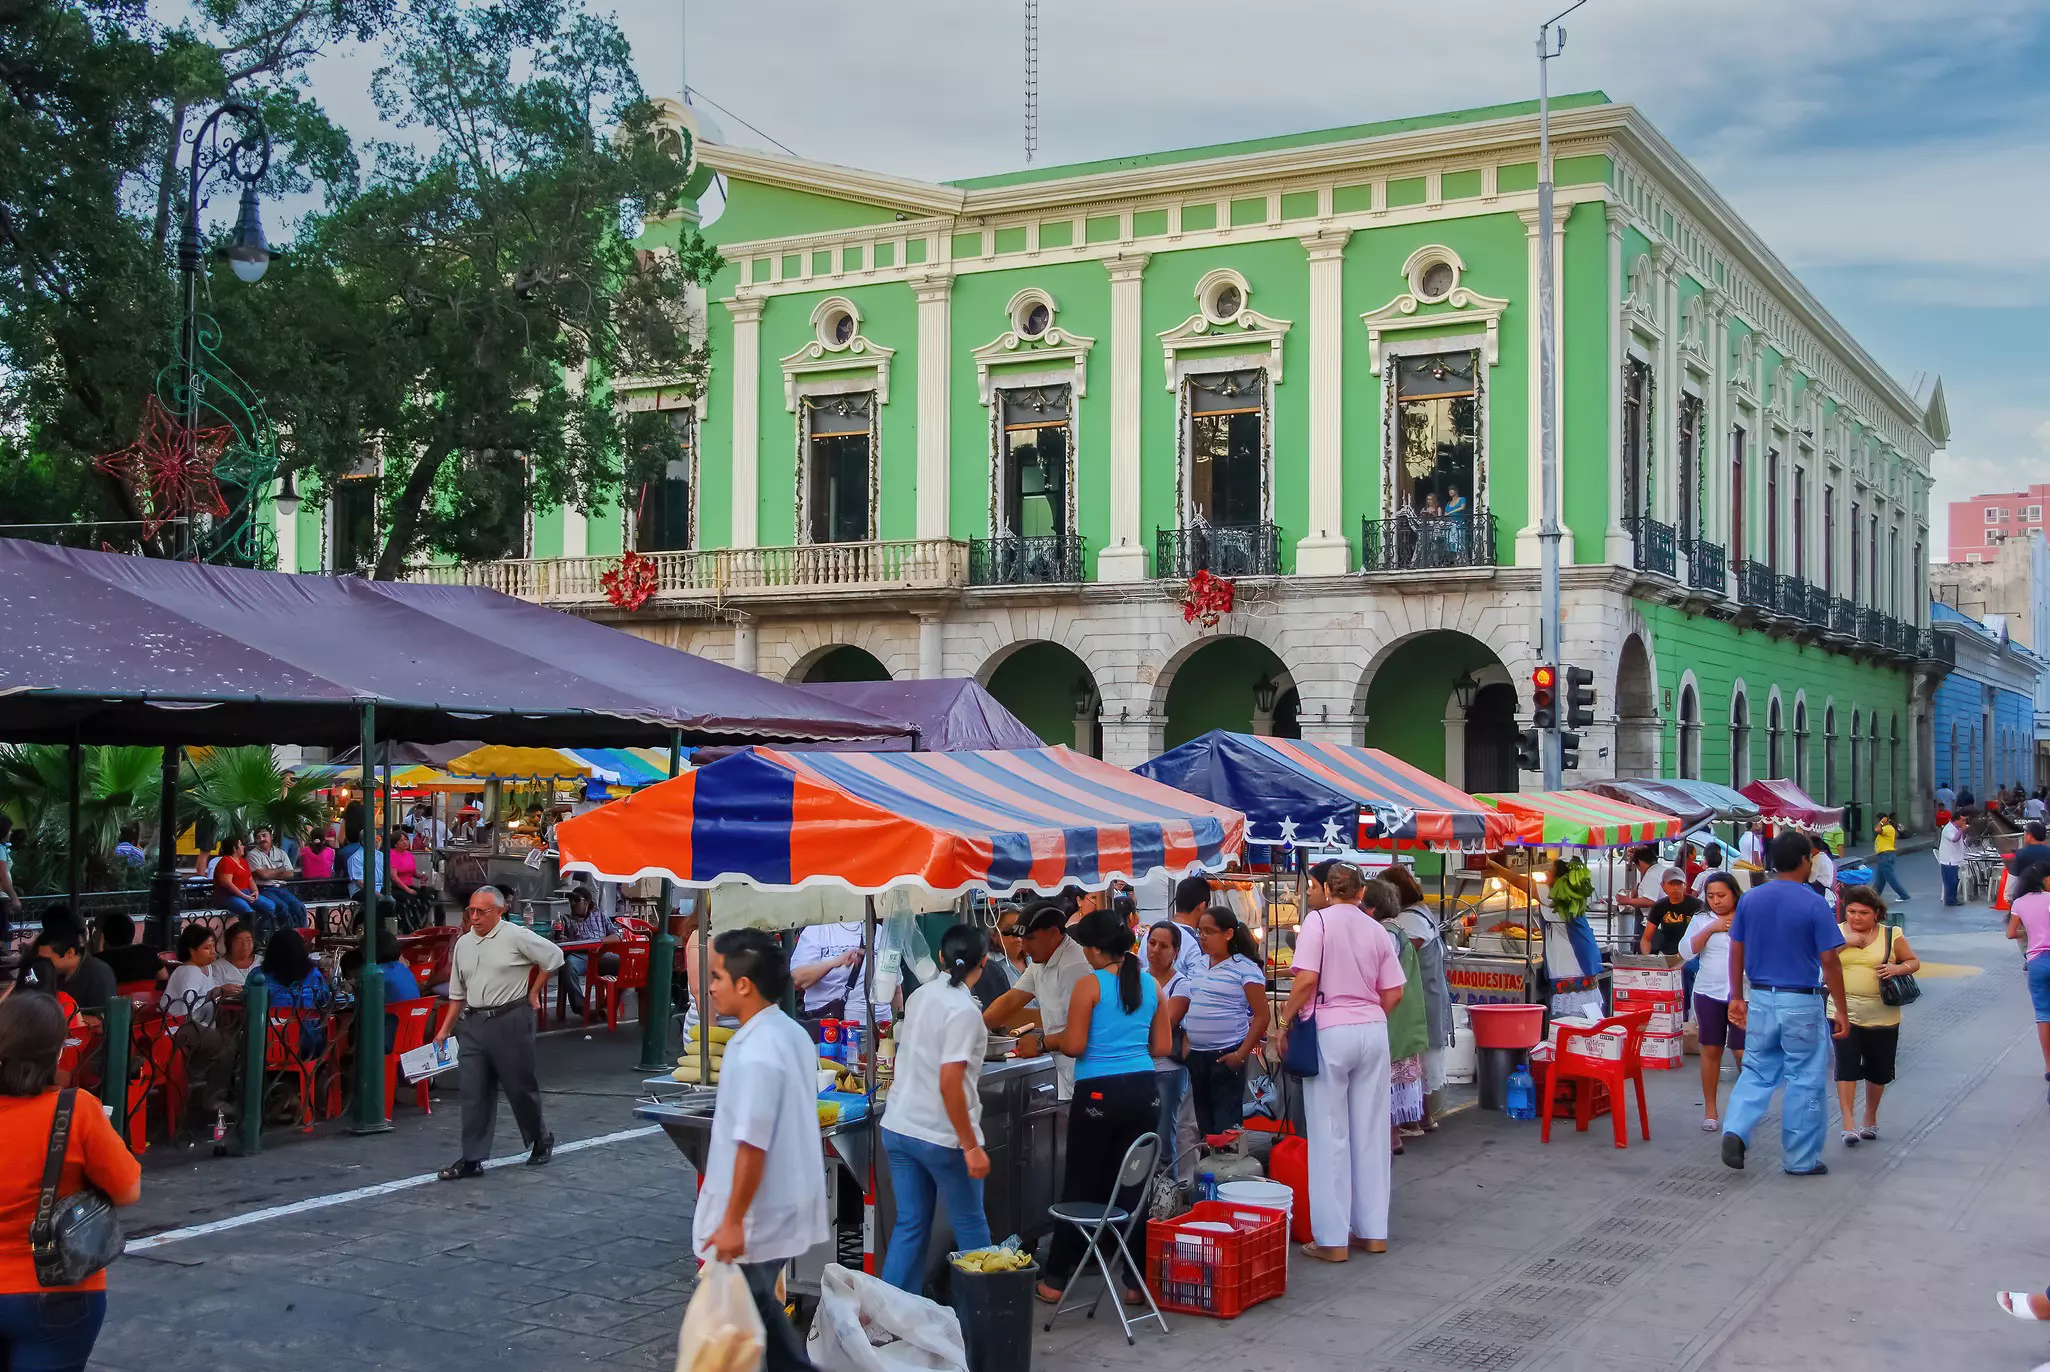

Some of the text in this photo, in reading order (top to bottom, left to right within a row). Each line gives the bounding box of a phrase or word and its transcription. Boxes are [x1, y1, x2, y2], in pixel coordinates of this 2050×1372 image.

[1012, 924, 1026, 936] 70
[1447, 969, 1524, 991] MARQUESITAS
[1584, 1038, 1605, 1047] Golden
[51, 1107, 72, 1153] TOUS
[36, 1184, 56, 1232] TOUS
